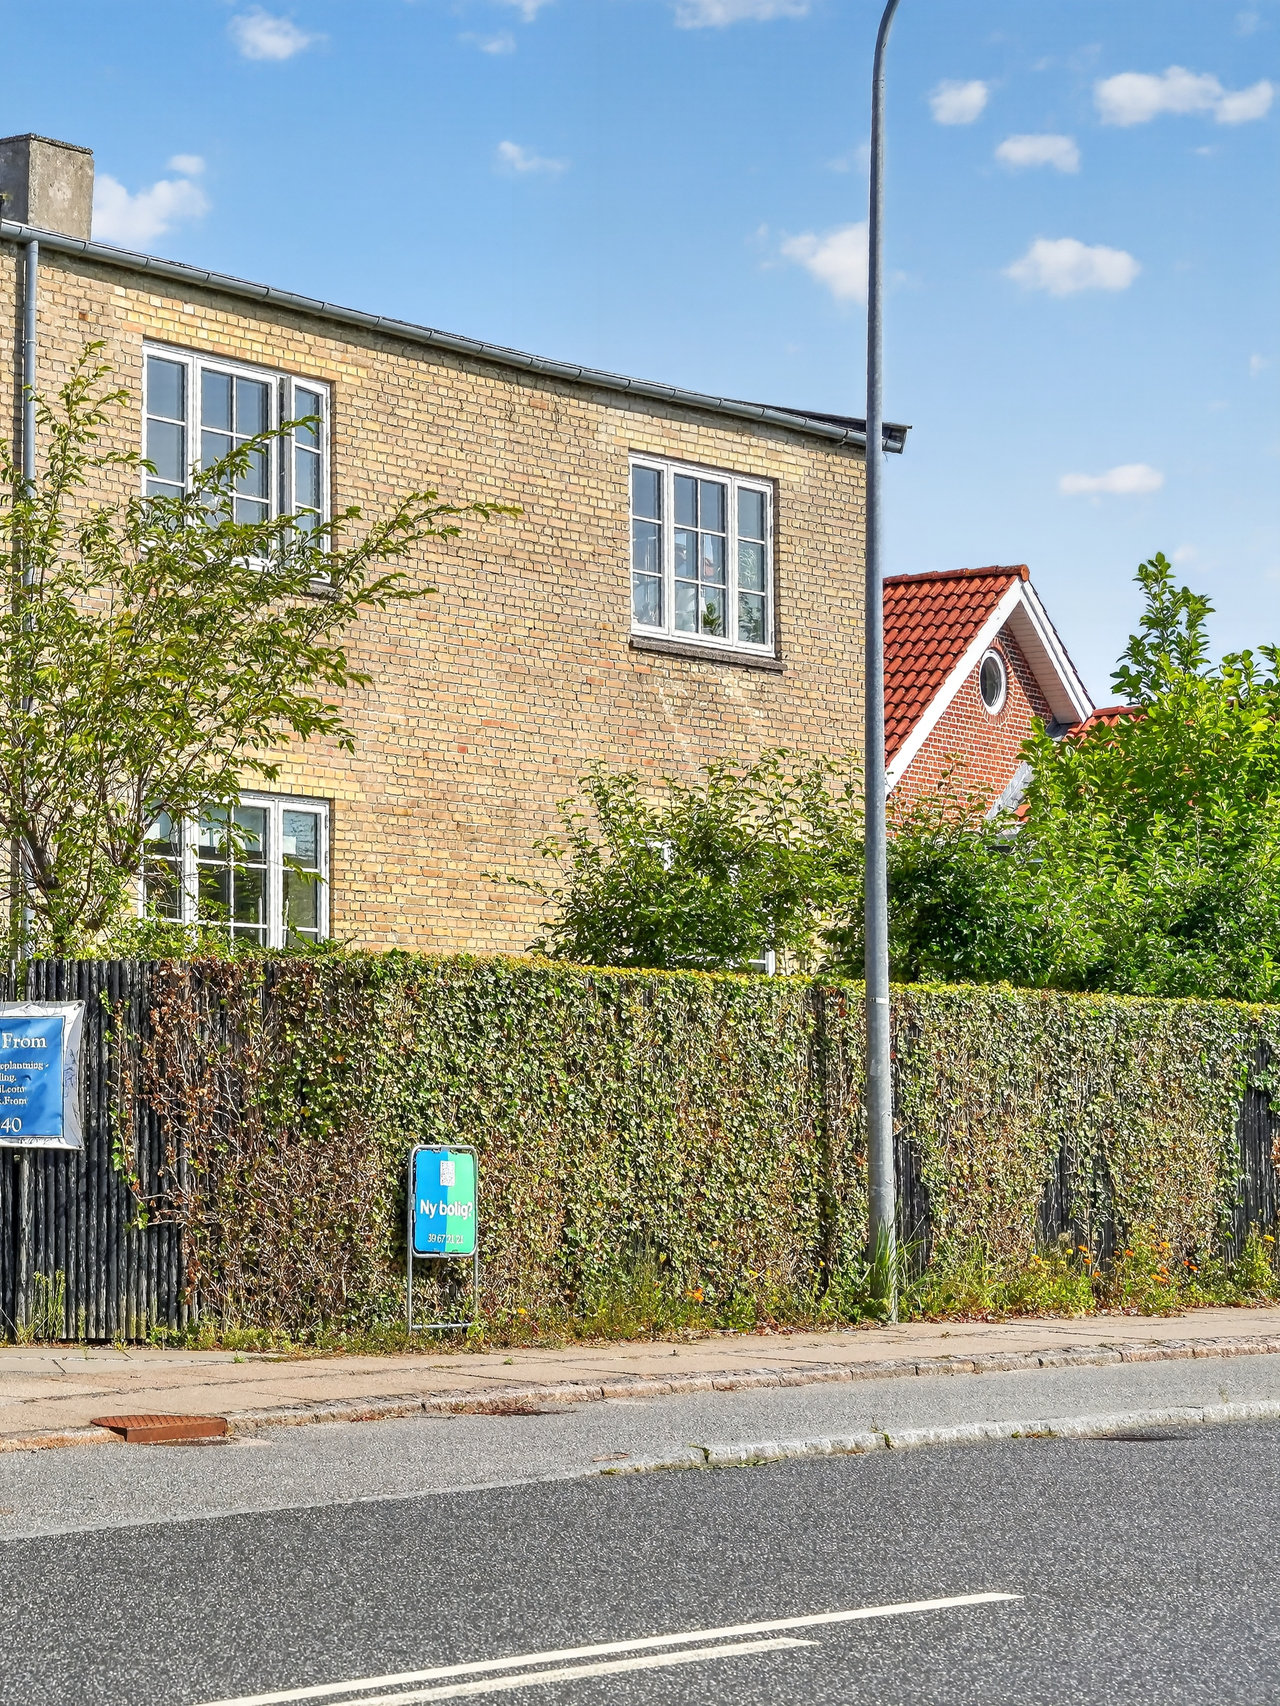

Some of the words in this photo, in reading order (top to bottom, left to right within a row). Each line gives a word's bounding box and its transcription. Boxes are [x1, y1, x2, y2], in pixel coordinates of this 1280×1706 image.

[2, 1032, 47, 1049] From
[420, 1199, 437, 1219] Ny
[439, 1200, 473, 1220] bolig?
